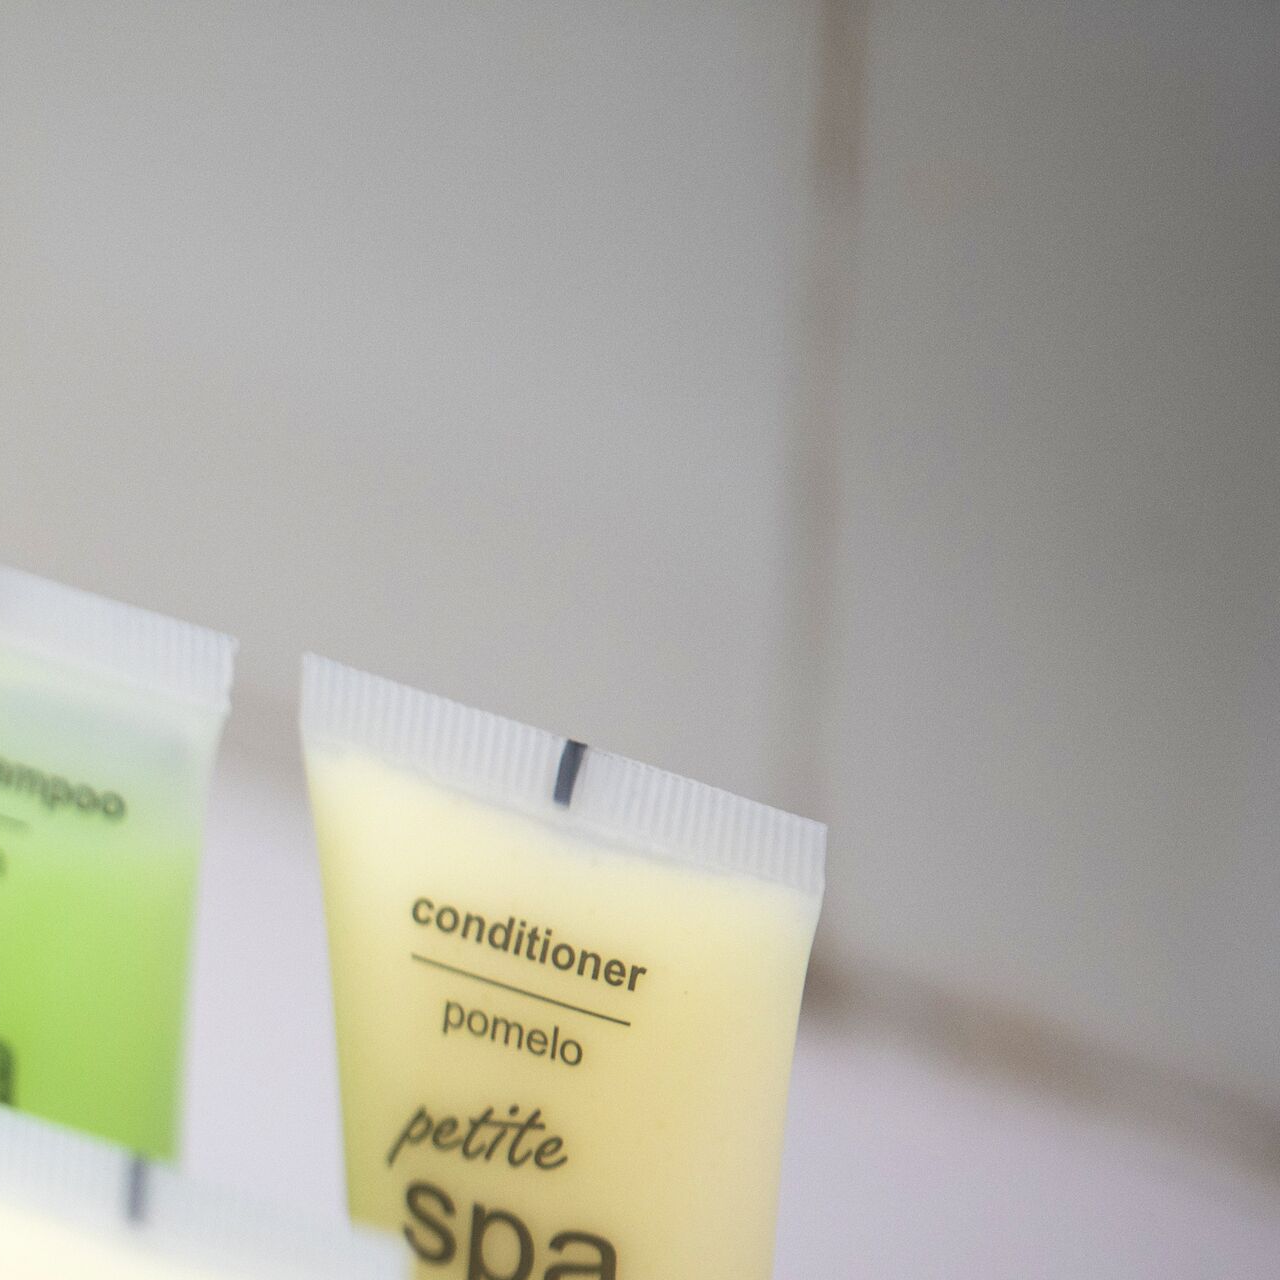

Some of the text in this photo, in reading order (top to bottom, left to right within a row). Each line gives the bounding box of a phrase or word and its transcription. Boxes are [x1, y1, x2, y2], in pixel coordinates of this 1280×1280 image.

[410, 896, 648, 992] conditioner
[441, 999, 584, 1067] pomelo
[385, 1103, 569, 1171] petite
